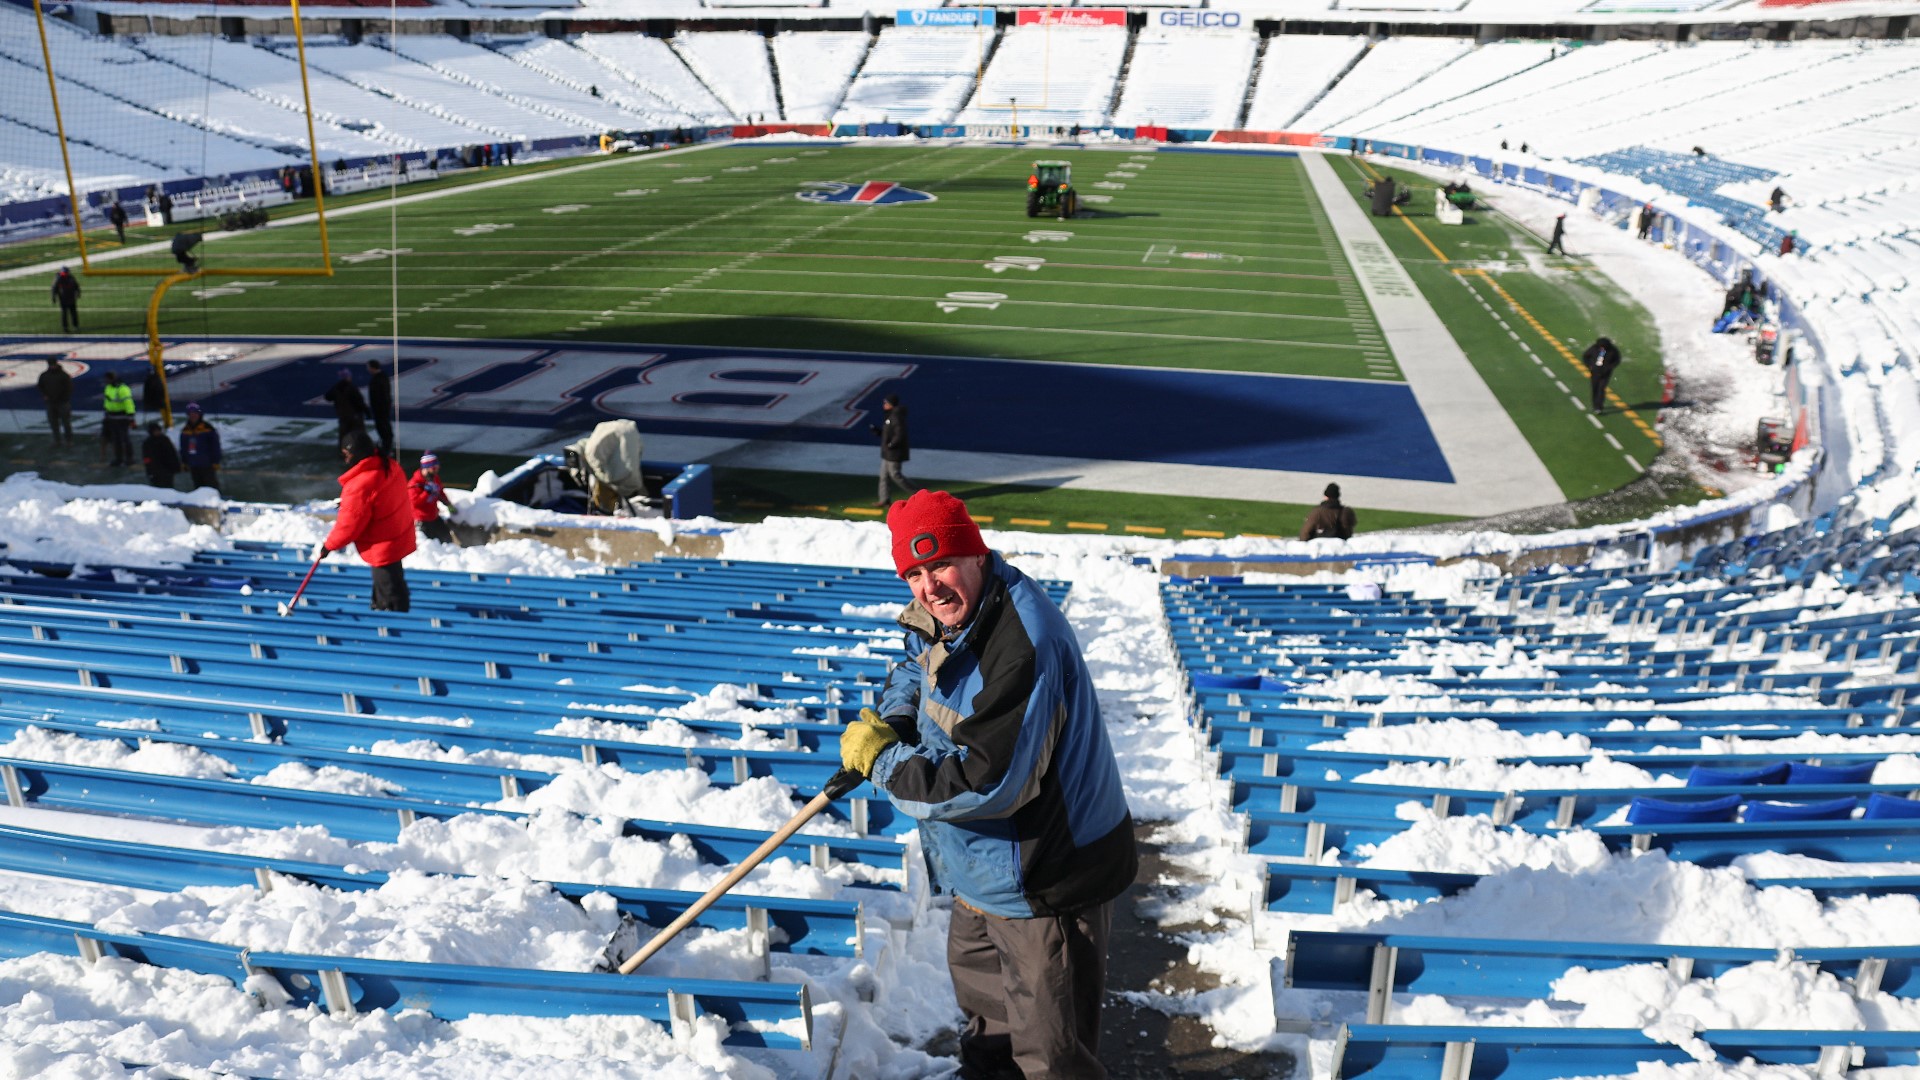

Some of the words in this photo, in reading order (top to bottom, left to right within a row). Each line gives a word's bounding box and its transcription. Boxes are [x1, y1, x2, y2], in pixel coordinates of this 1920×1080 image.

[1037, 11, 1059, 25] Tim
[1060, 10, 1104, 25] Hortons
[1160, 11, 1240, 27] GEICO
[935, 290, 1008, 313] 10
